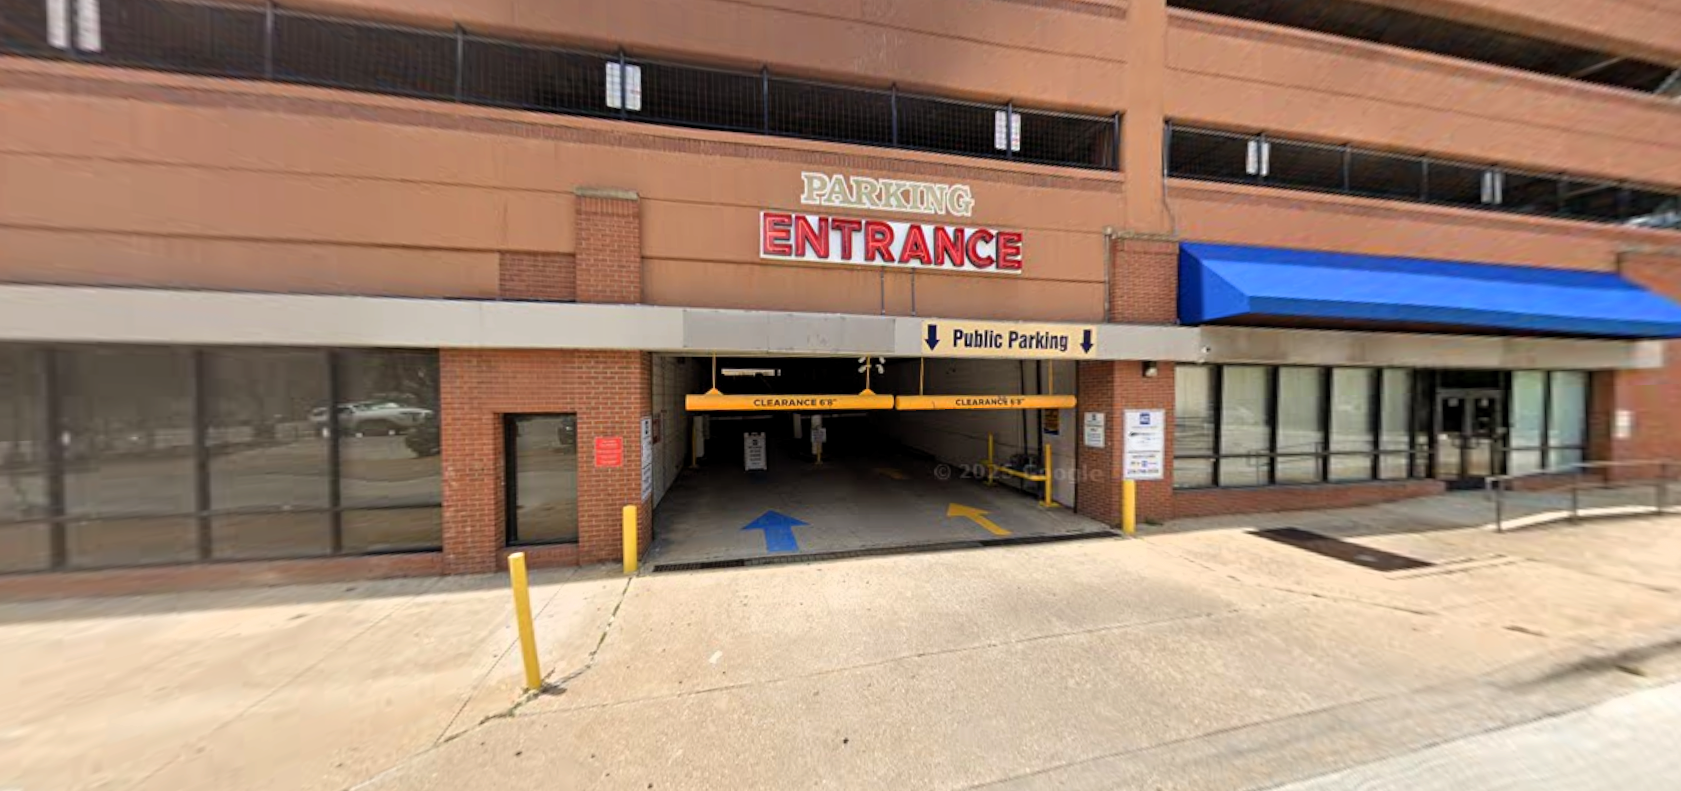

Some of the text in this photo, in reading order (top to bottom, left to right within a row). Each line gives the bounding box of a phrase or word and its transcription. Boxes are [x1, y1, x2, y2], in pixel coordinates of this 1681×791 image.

[801, 171, 974, 216] PARKING
[763, 211, 1023, 270] ENTRANCE
[953, 329, 1069, 352] Public Parking
[753, 398, 816, 407] CLEARANCE
[955, 398, 1008, 406] CLEARANCE
